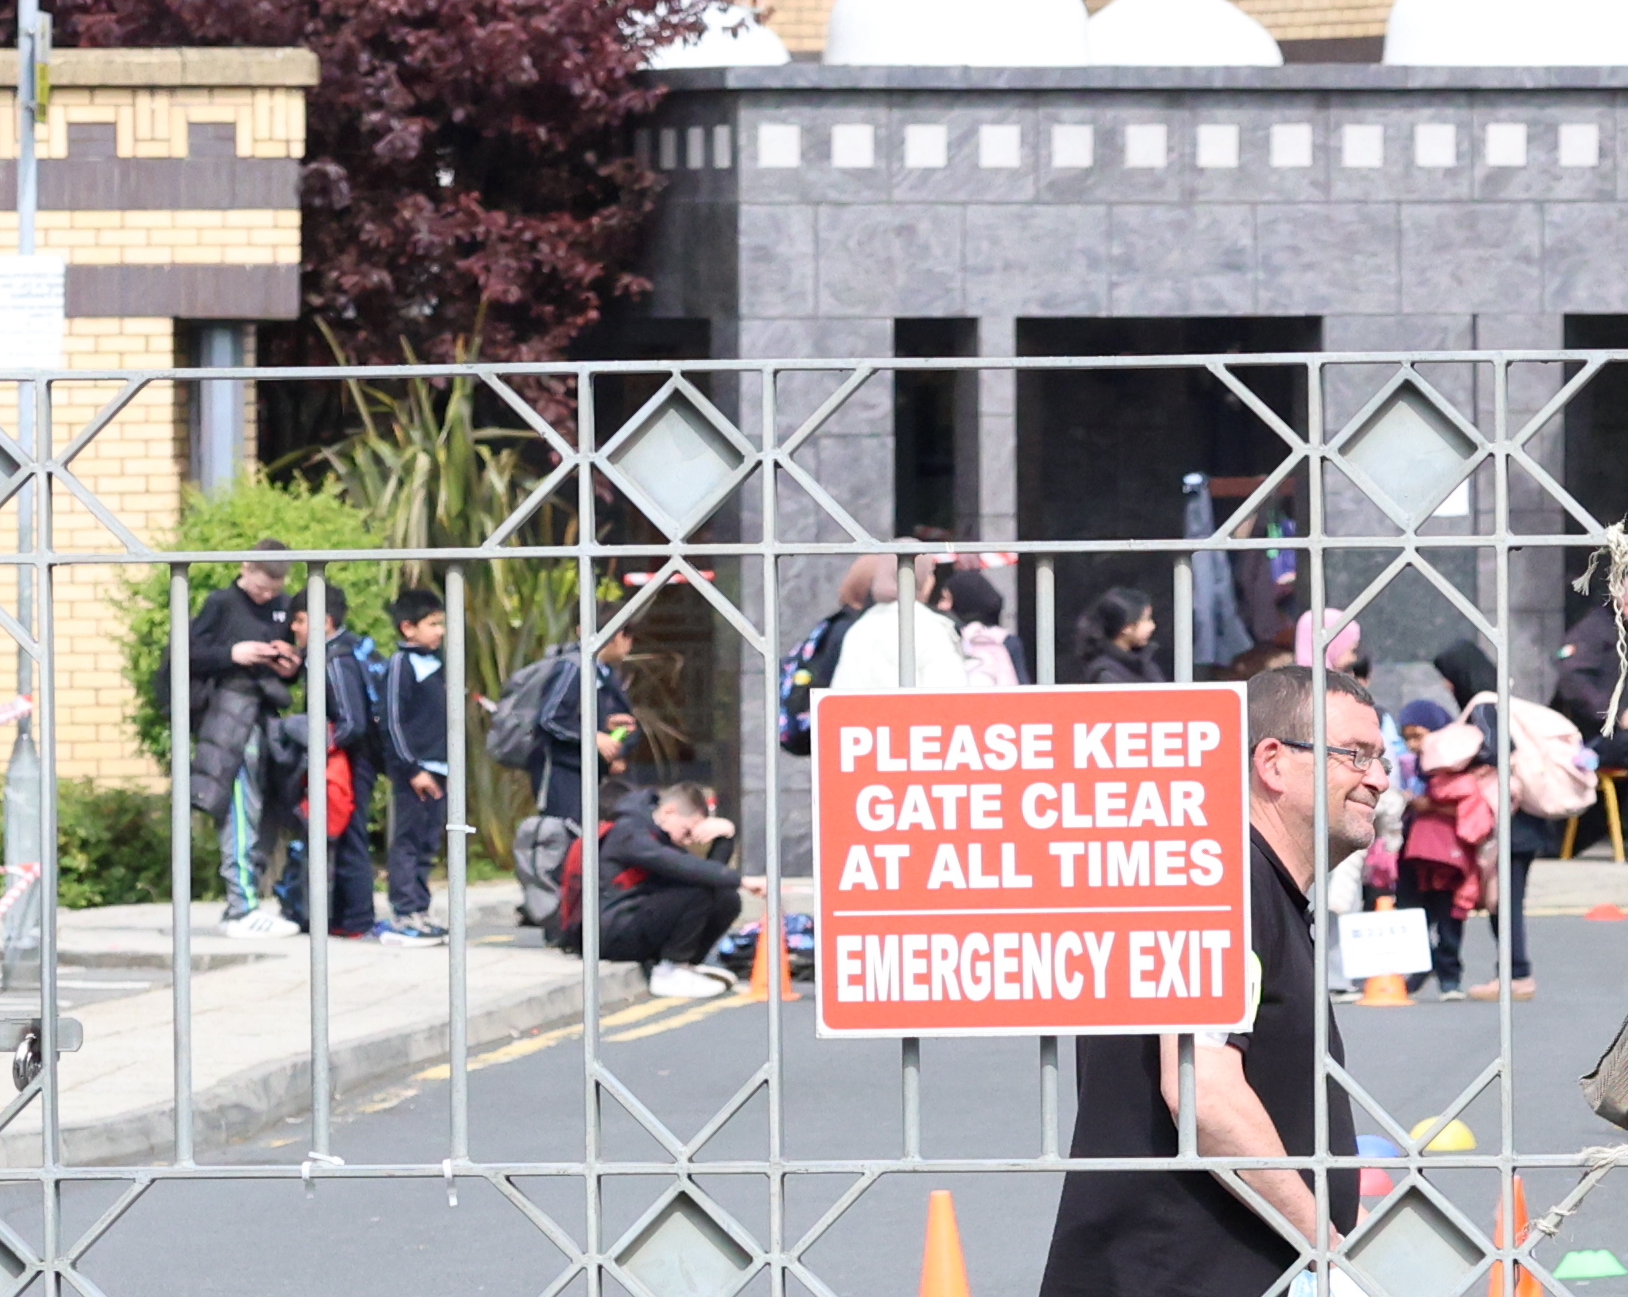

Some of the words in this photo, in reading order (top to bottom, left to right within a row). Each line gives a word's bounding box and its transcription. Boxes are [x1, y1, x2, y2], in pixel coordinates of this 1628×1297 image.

[839, 723, 1054, 773] PLEASE
[1072, 721, 1221, 770] KEEP
[855, 783, 1004, 832] GATE
[1021, 780, 1208, 830] CLEAR
[838, 843, 911, 891] AT
[926, 842, 1033, 890] ALL
[1048, 838, 1225, 888] TIMES
[835, 930, 1116, 1003] EMERGENCY
[1128, 929, 1232, 999] EXIT
